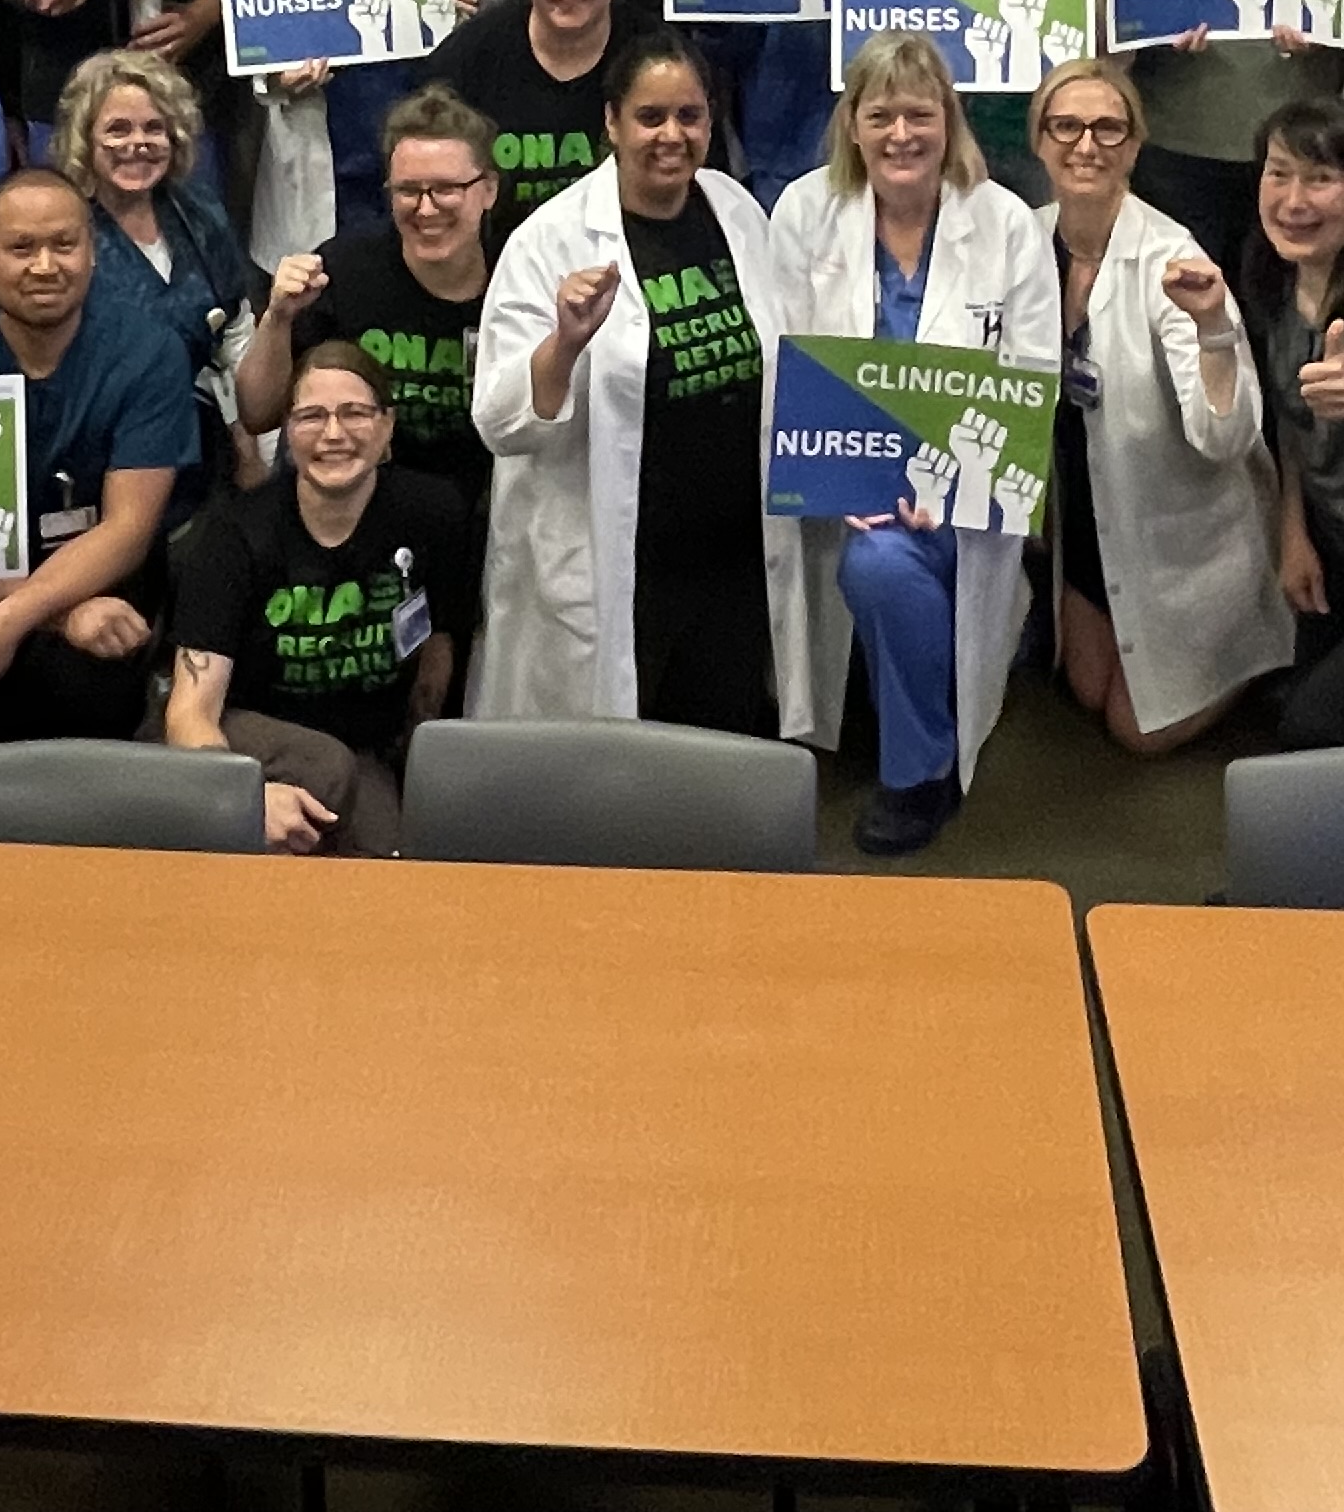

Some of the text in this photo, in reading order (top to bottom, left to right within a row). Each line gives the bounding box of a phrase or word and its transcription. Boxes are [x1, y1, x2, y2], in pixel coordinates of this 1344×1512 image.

[847, 7, 960, 31] NURSES
[492, 131, 595, 170] ONA
[642, 266, 721, 314] NA
[656, 304, 744, 349] RECRU
[360, 328, 465, 376] ONA
[857, 363, 1043, 407] CLINICIANS
[777, 431, 901, 457] NURSES
[265, 581, 364, 627] ONA
